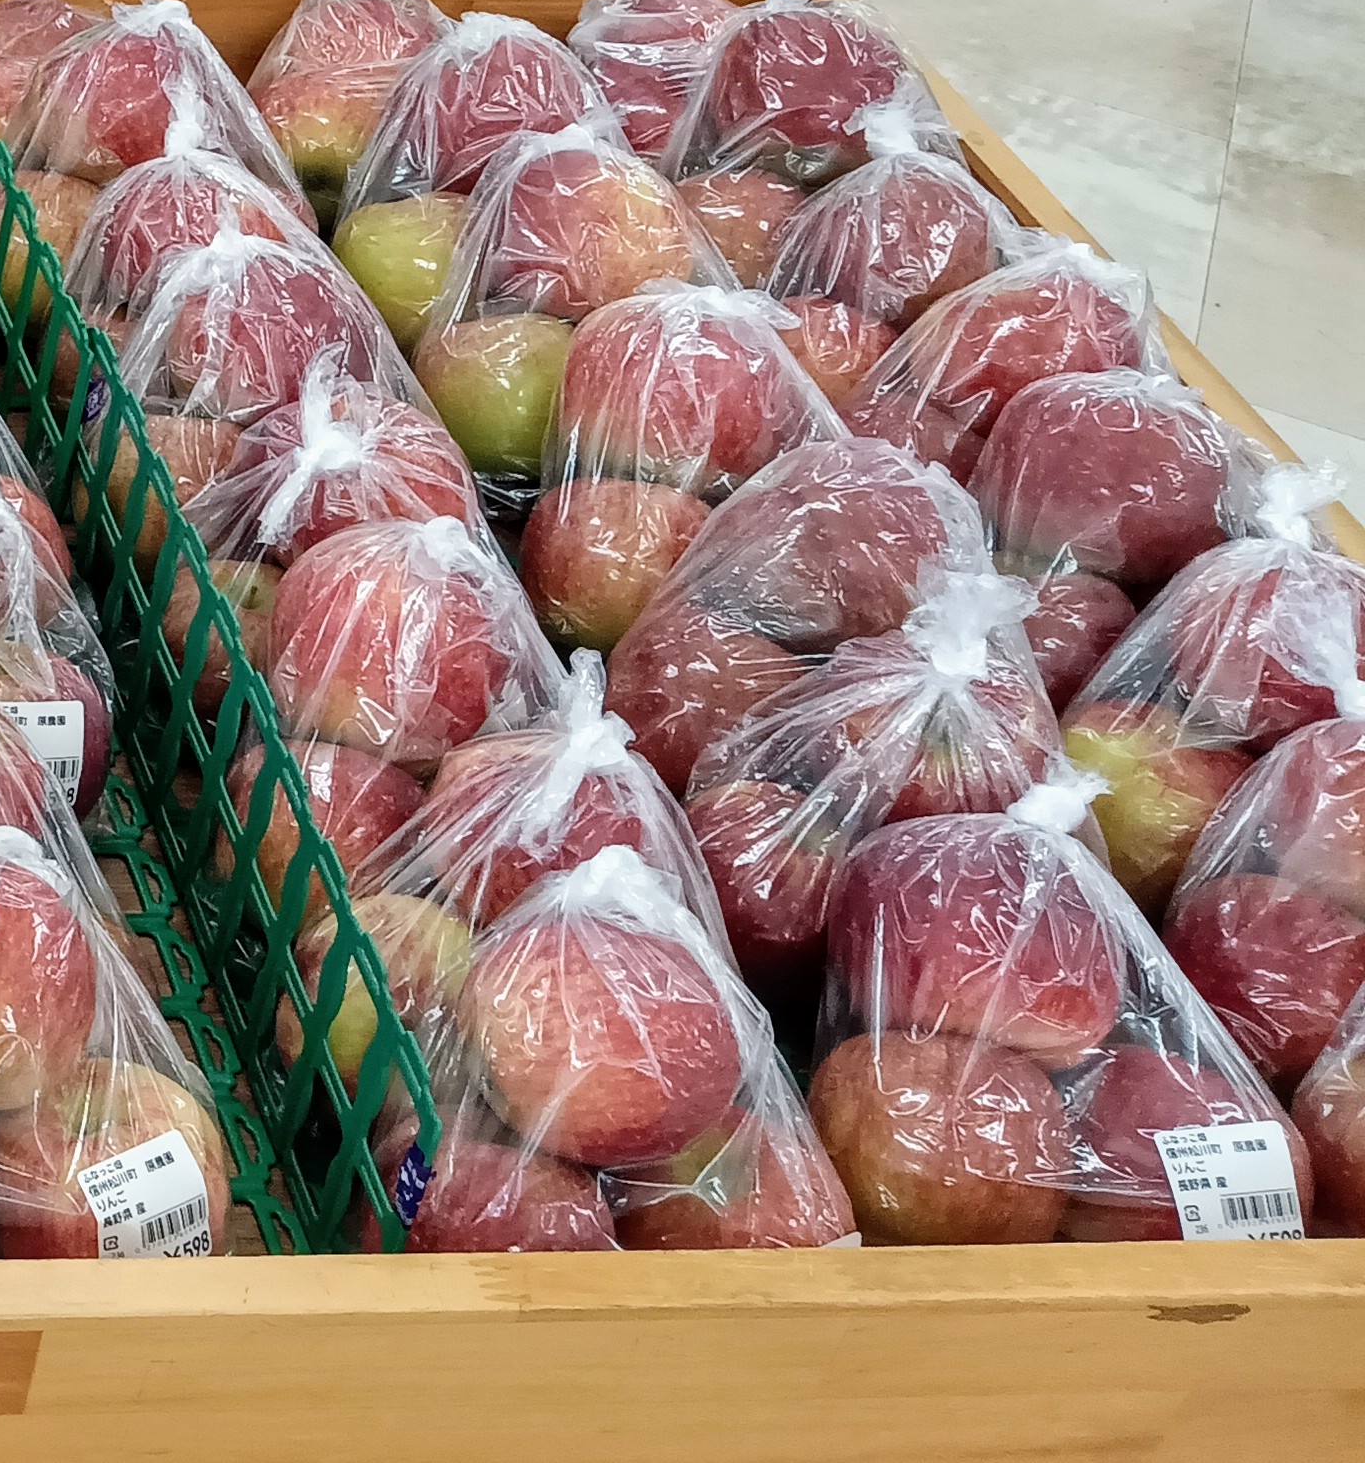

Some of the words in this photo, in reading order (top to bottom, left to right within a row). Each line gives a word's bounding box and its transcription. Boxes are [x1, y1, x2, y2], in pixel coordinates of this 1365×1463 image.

[1166, 1144, 1222, 1159] 信州松川町
[1172, 1160, 1207, 1174] りんご
[89, 1169, 138, 1197] 信州松川町
[1178, 1178, 1211, 1192] 長野県
[96, 1191, 127, 1212] りんご
[103, 1208, 133, 1228] 長野県
[136, 1202, 146, 1215] 産
[164, 1230, 210, 1257] ¥598
